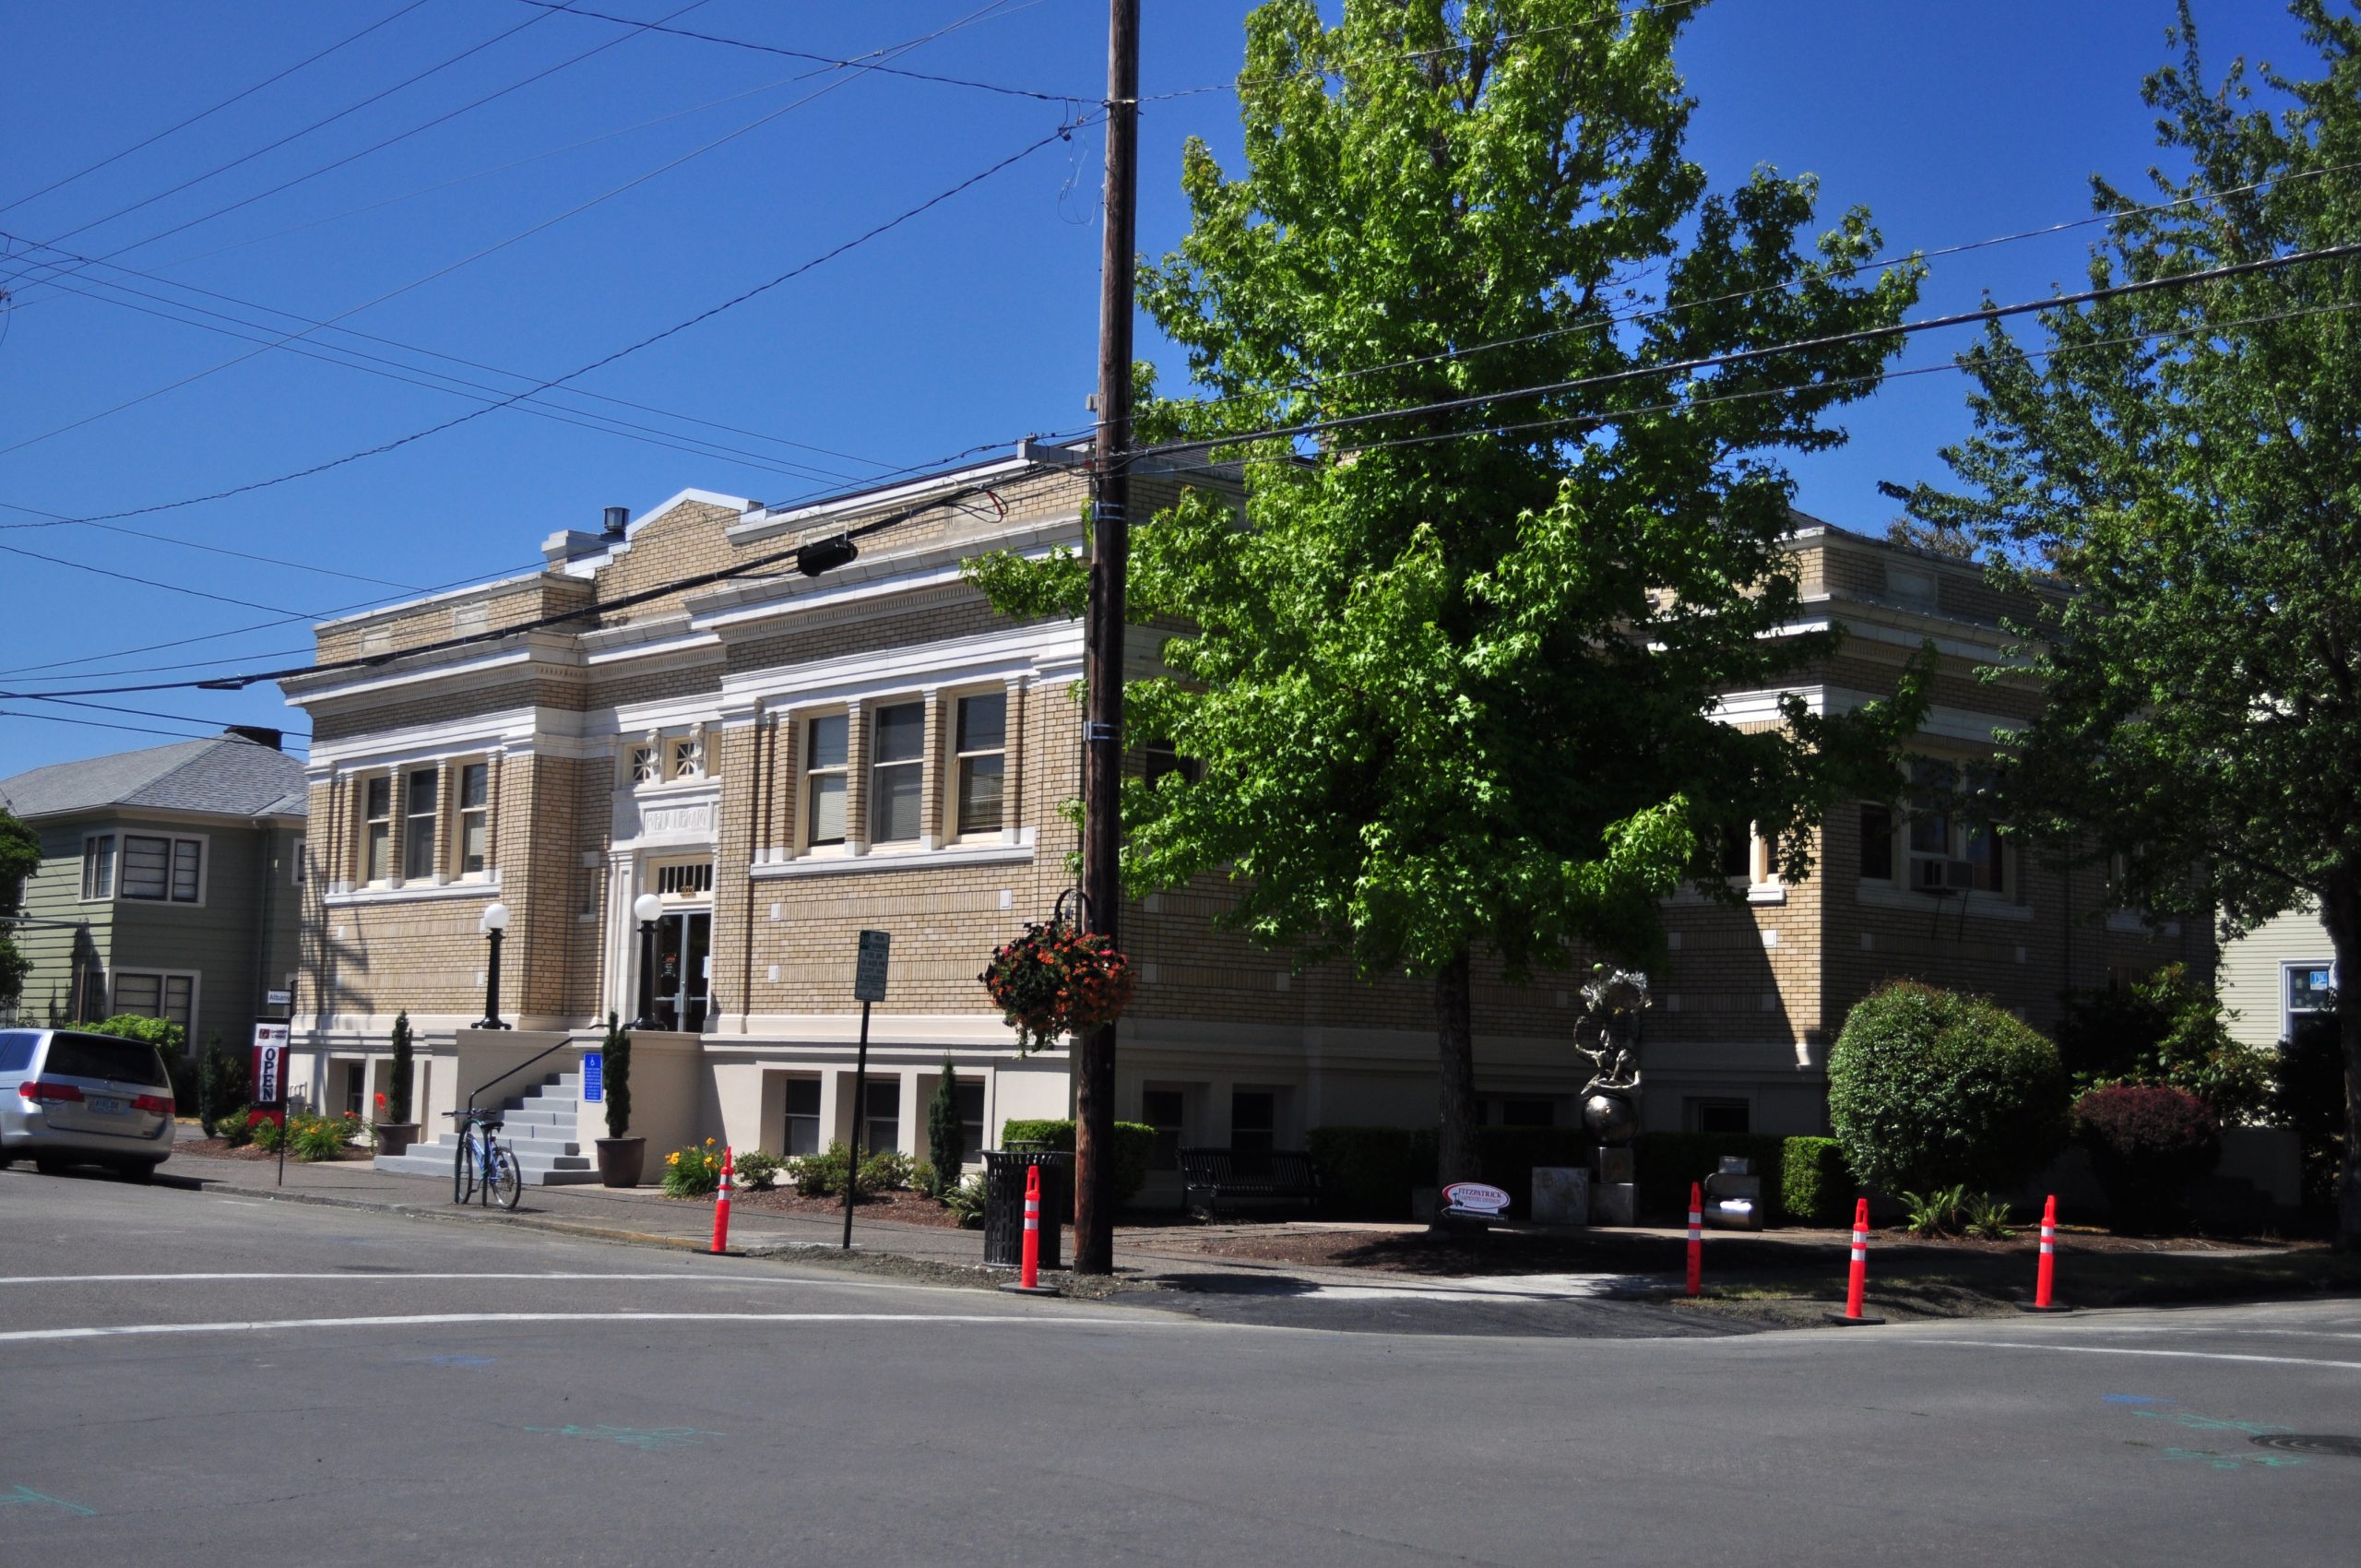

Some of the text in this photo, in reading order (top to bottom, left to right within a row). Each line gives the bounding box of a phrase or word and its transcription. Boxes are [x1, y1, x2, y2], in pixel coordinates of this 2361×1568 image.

[673, 808, 708, 828] LIBRARY
[263, 1048, 276, 1101] OPEN
[1458, 1188, 1501, 1198] FITZPATRICK
